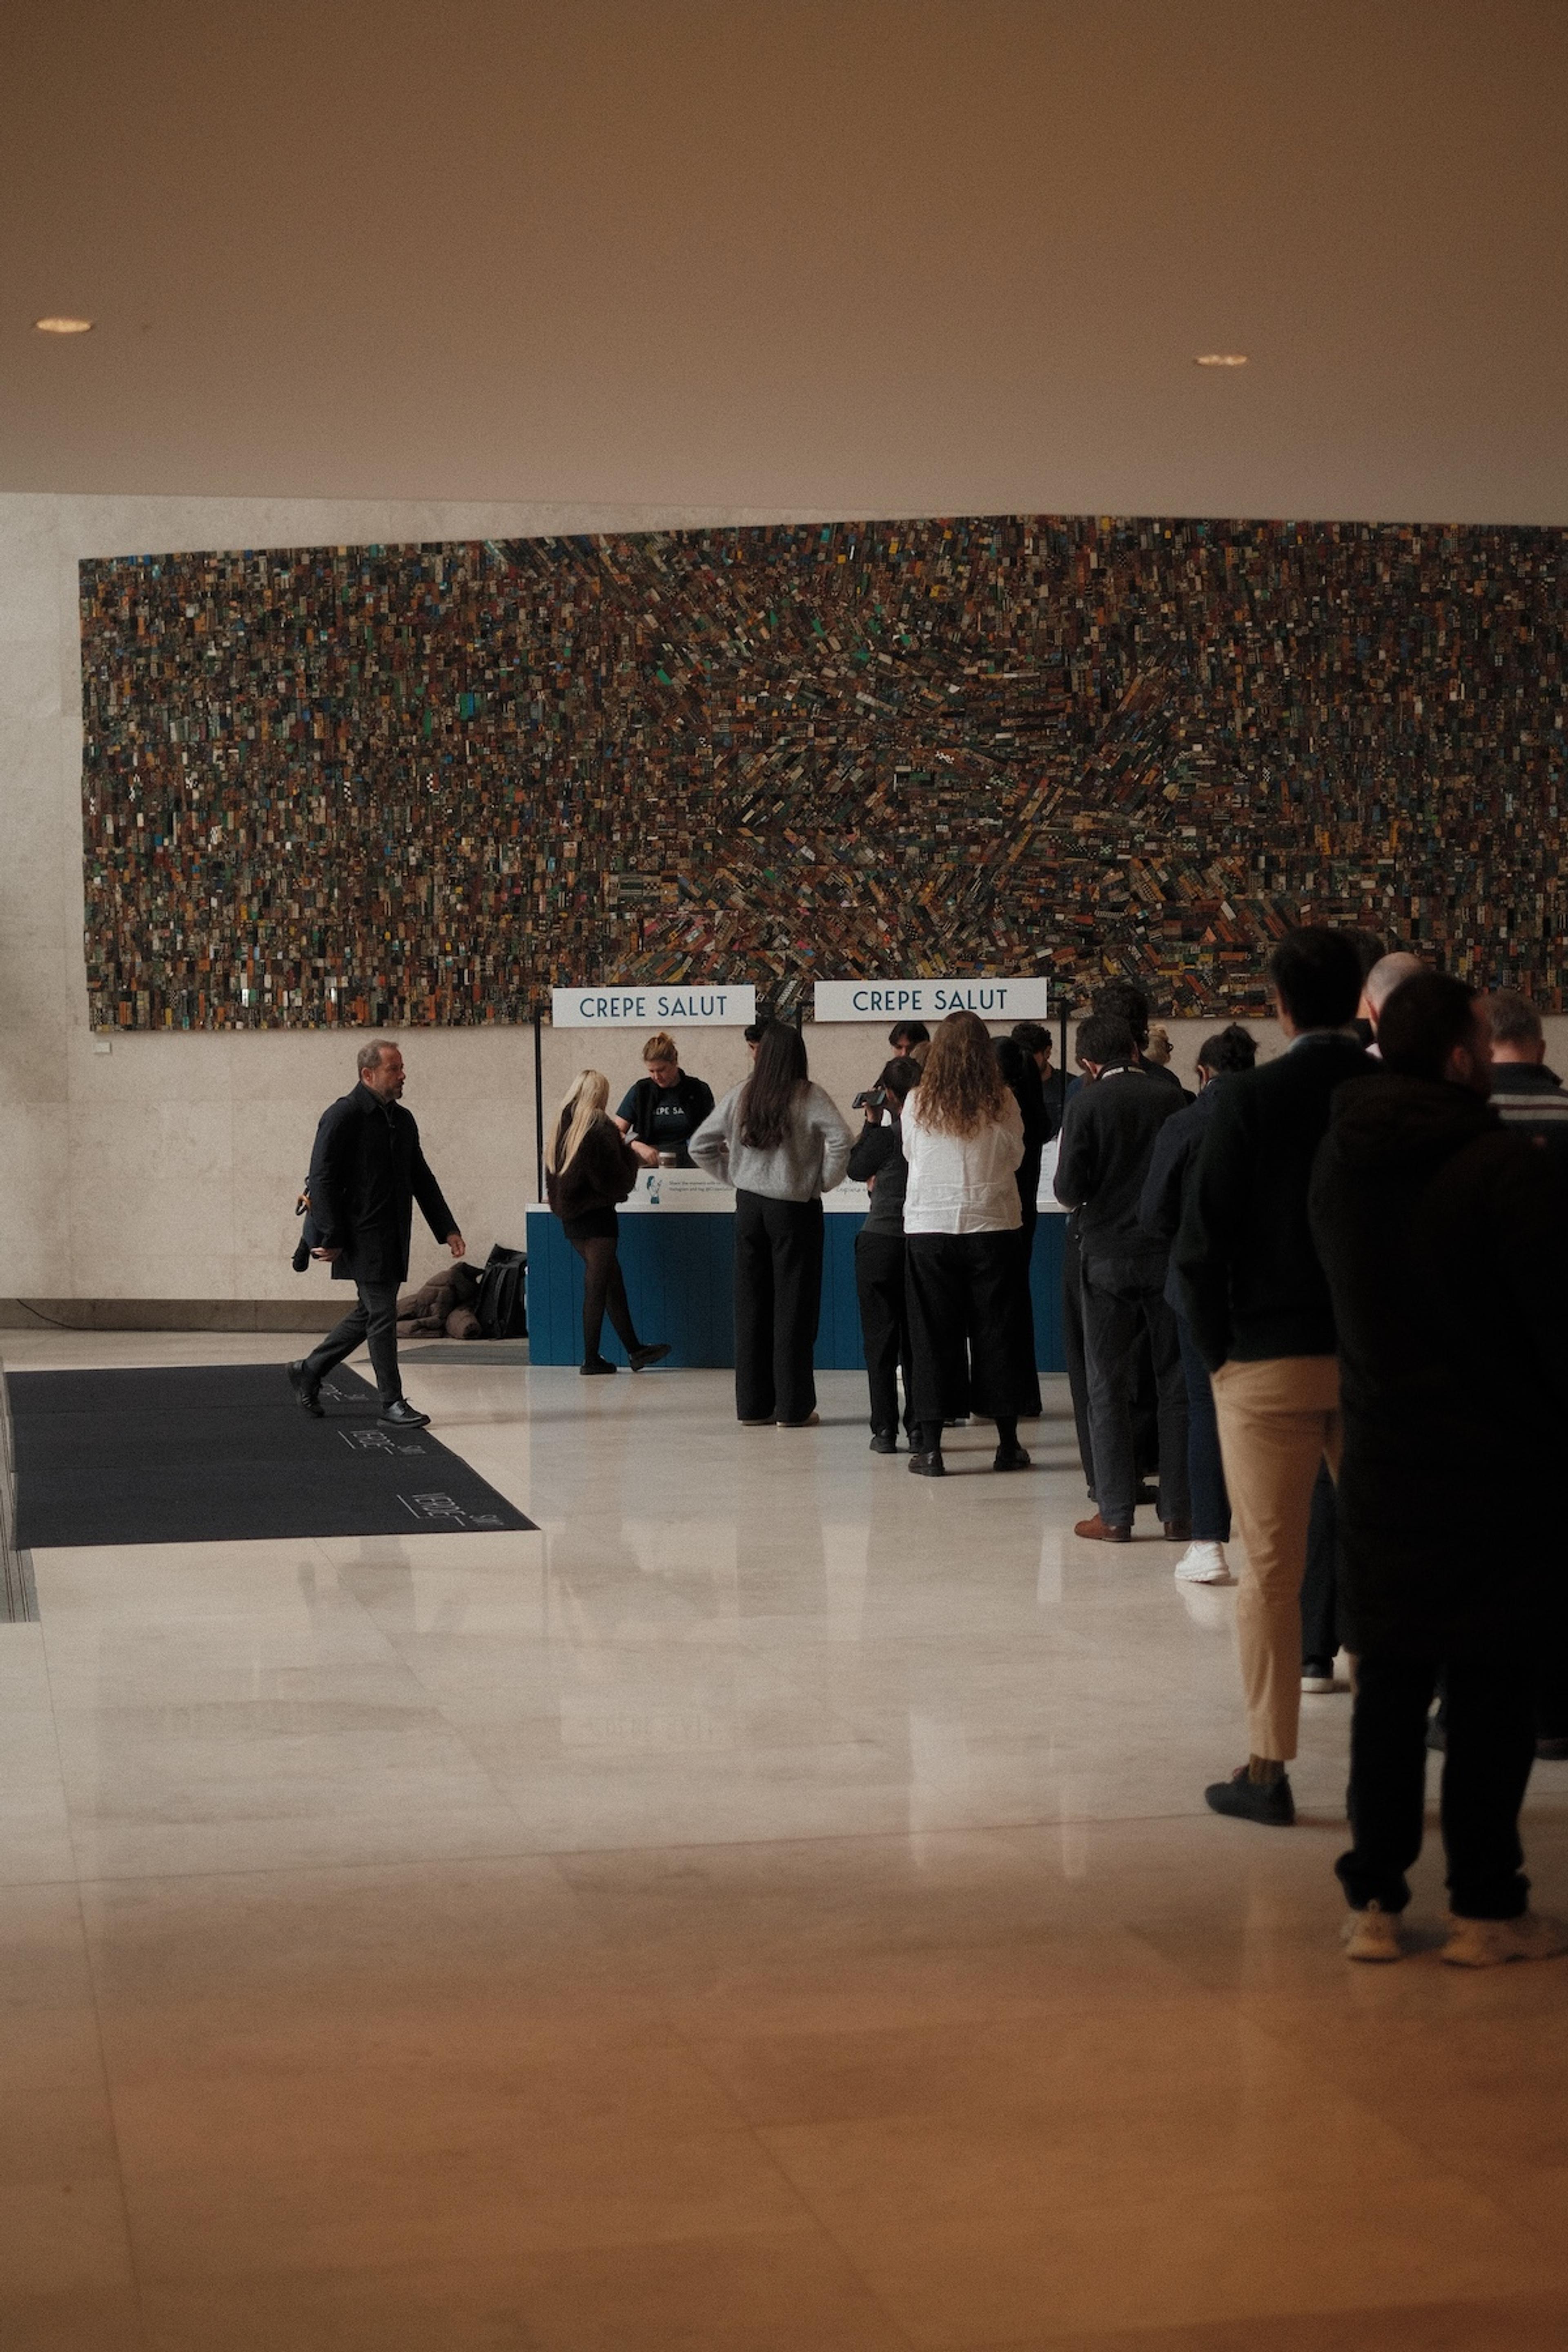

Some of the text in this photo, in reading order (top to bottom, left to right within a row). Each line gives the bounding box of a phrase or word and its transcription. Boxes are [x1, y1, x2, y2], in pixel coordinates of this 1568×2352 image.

[579, 996, 727, 1017] CREPE SALUT
[853, 989, 1007, 1011] CREPE SALUT
